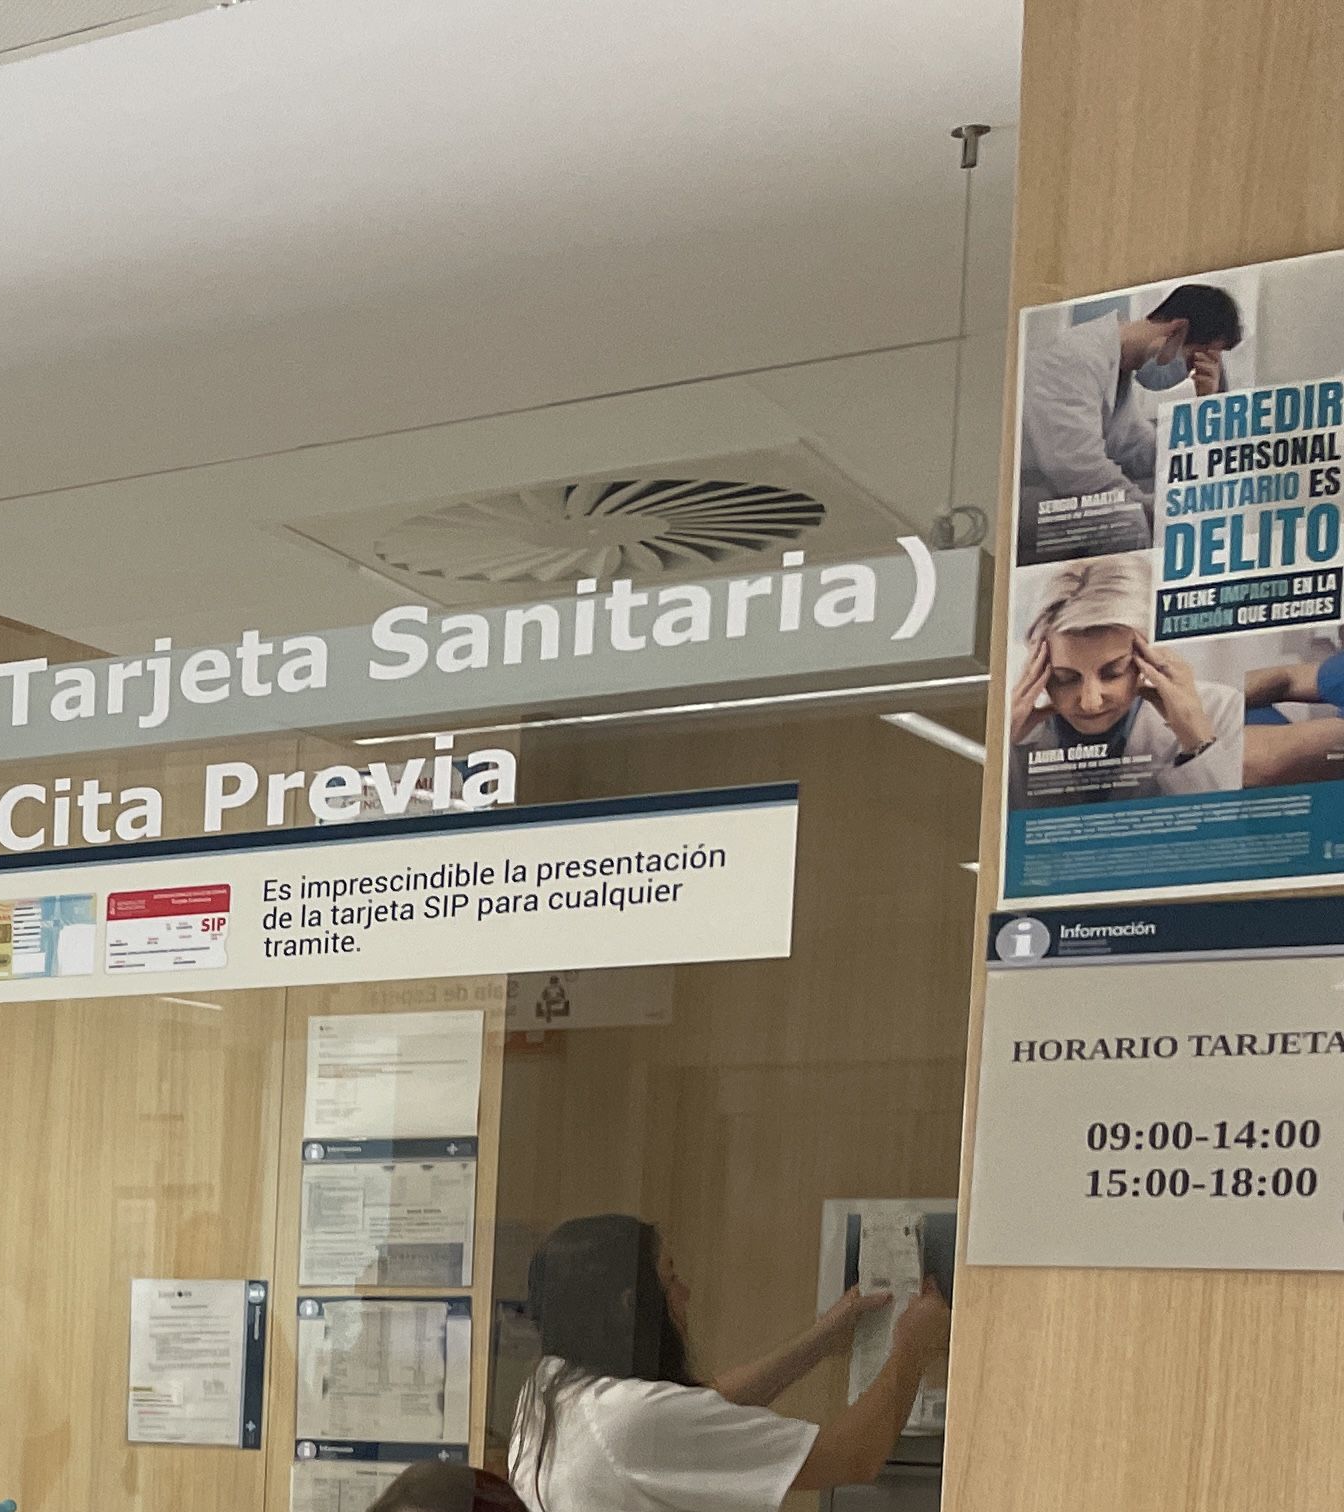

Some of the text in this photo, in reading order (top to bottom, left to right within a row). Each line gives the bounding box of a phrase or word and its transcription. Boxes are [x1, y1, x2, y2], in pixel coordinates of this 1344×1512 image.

[1168, 381, 1342, 450] AGREDIR
[1168, 431, 1342, 484] AL PERSONAL
[1165, 467, 1341, 517] SANITARIO ES
[1163, 503, 1341, 583] DELITO
[369, 534, 938, 682] Sanitaria)
[1162, 573, 1337, 612] Y TIENE IMPACTO EN LA
[1162, 597, 1334, 634] ATENCIÓN QUE RECIBES
[203, 734, 517, 833] Previa
[263, 843, 727, 904] Es imprescindible la presentación
[201, 917, 226, 932] SIP
[262, 879, 683, 931] de la tarjeta SIP para cualquier
[263, 930, 361, 958] tramite.
[1060, 920, 1156, 939] Información
[1011, 1030, 1344, 1063] HORARIO TARJETA
[1086, 1118, 1321, 1151] 09:00-14:00
[1084, 1167, 1318, 1198] 15:00-18:00
